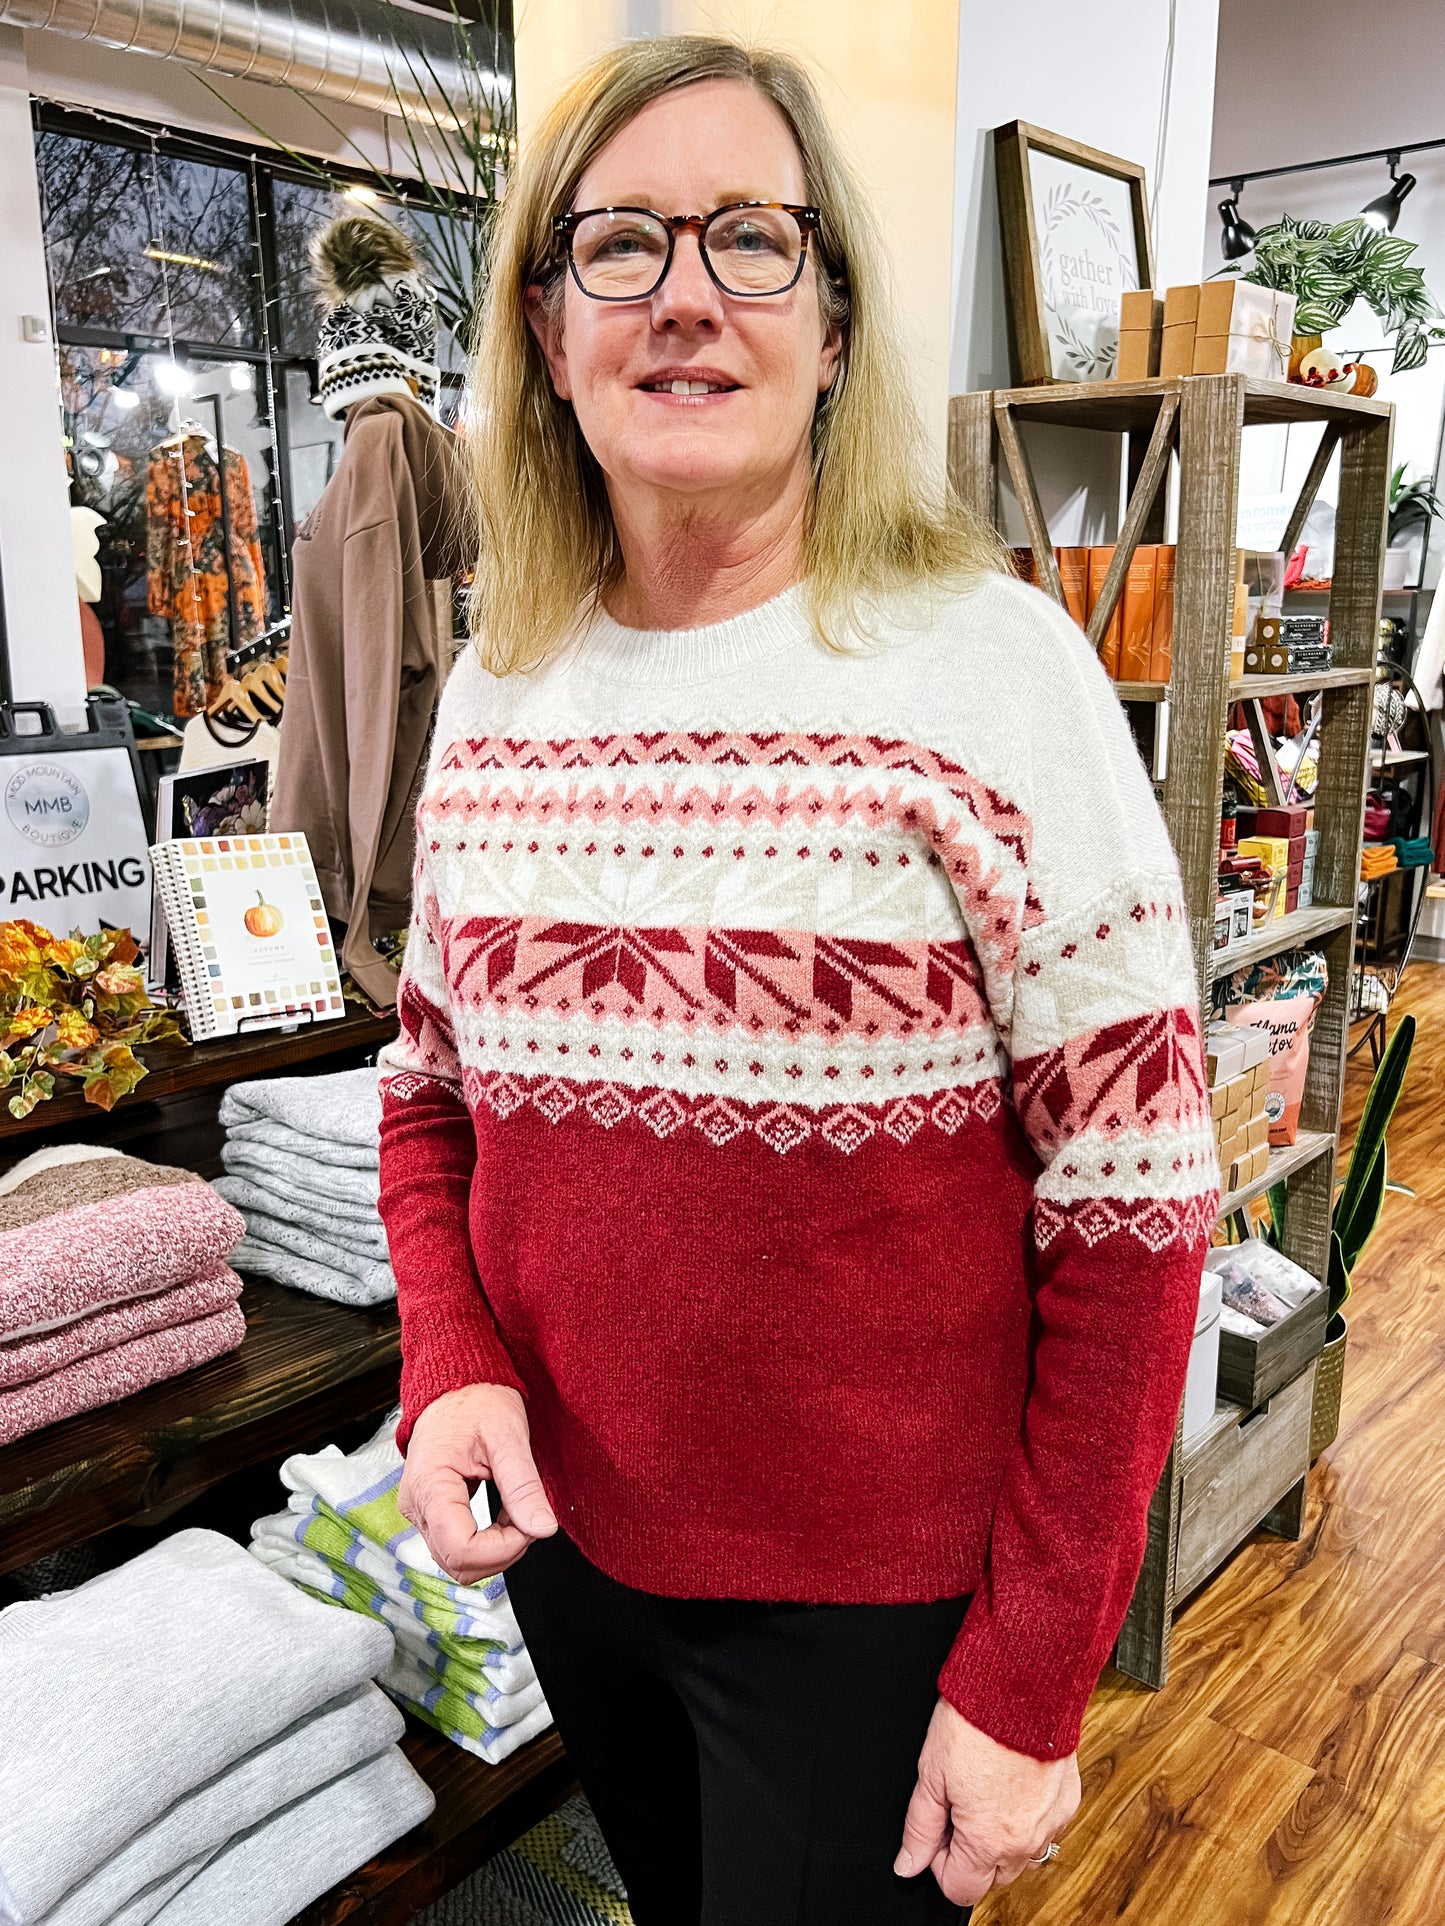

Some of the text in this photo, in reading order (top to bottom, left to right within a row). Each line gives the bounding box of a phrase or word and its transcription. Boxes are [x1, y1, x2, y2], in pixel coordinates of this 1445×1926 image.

[1060, 249, 1112, 286] gather
[1061, 286, 1118, 316] with love
[9, 765, 82, 800] MOD MOUNTAIN
[24, 795, 73, 815] MMB
[22, 819, 83, 844] BOUTIQUE
[1268, 1038, 1294, 1056] tox
